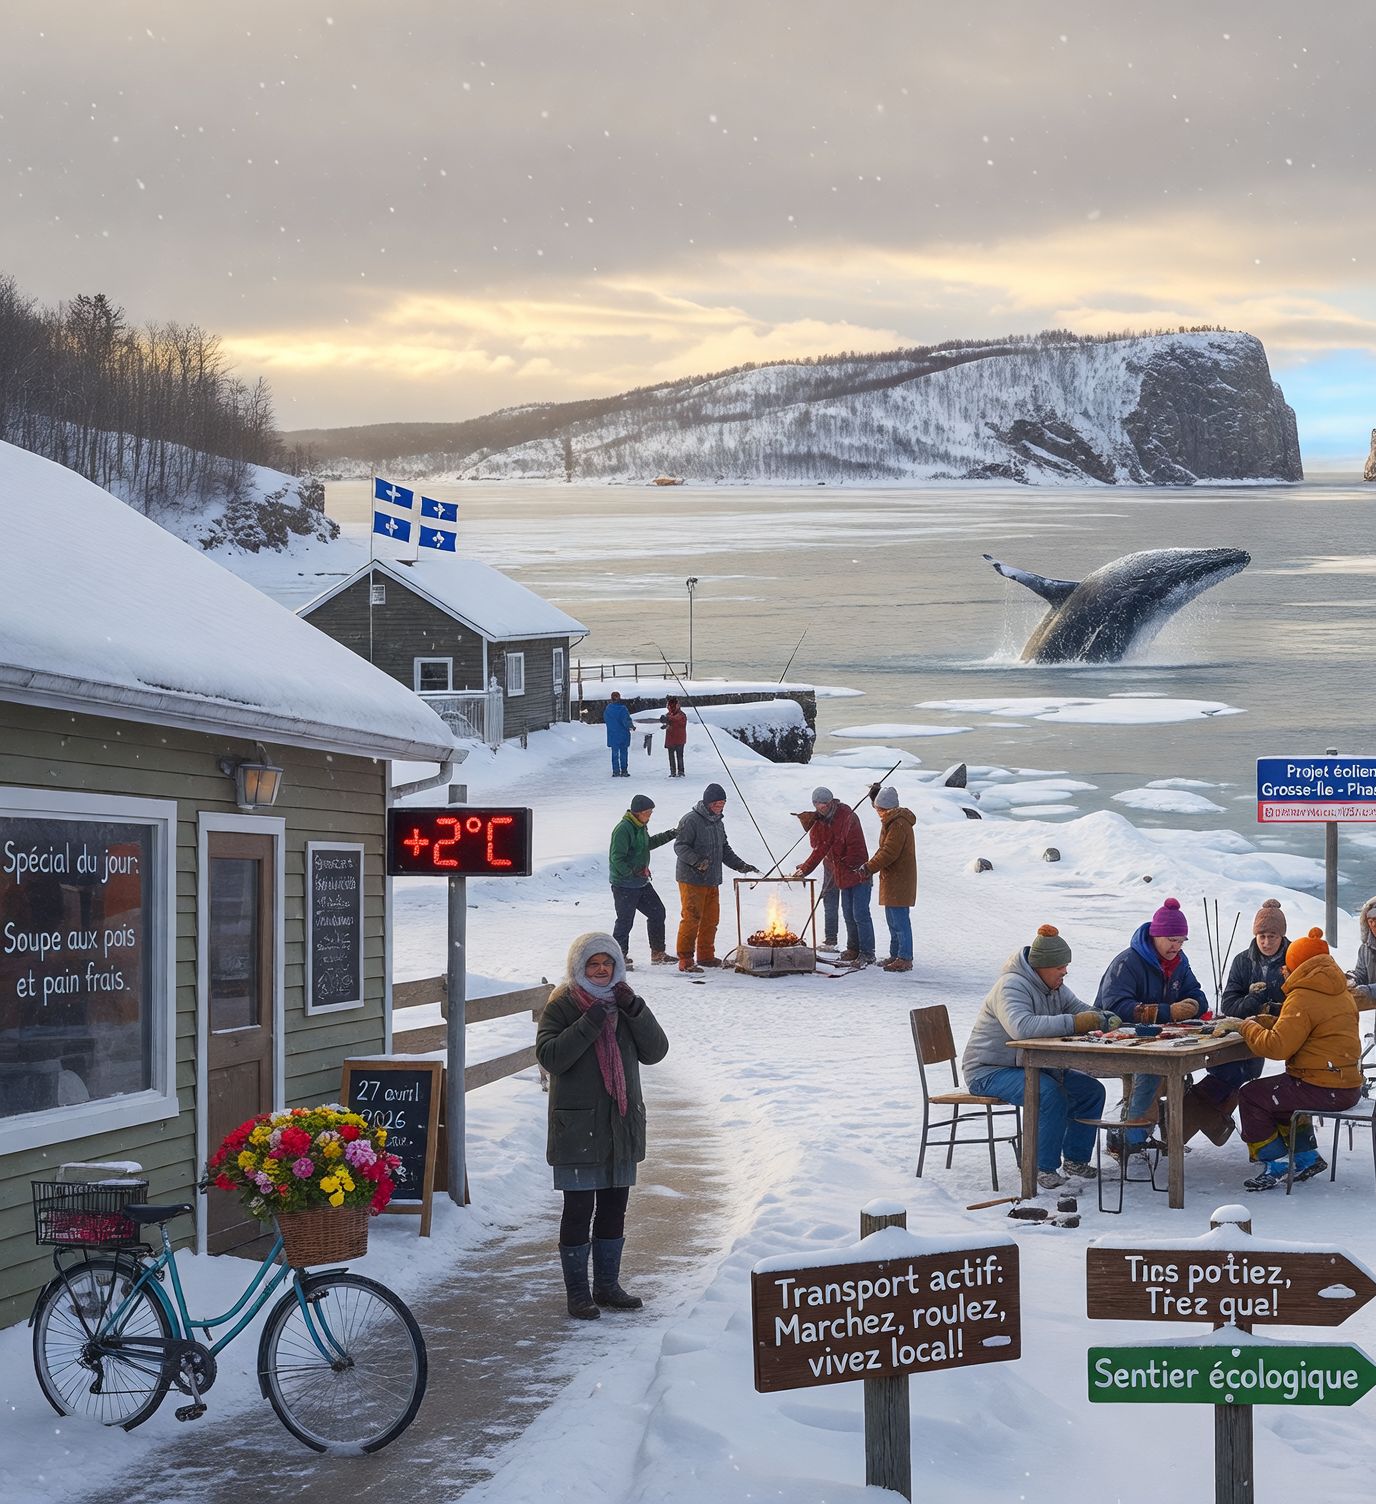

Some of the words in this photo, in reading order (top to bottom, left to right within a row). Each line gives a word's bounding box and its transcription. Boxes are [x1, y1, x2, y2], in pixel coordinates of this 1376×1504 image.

[1286, 764, 1329, 782] Projet
[3, 840, 70, 885] Spécial
[76, 843, 97, 874] du
[403, 816, 513, 867] +2°C
[4, 921, 61, 962] Soupe
[67, 930, 99, 951] aux
[104, 923, 136, 959] pois
[16, 968, 37, 998] et
[43, 968, 79, 1007] pain
[356, 1080, 381, 1101] 27
[774, 1264, 920, 1312] Transport
[929, 1255, 1004, 1293] actif:
[774, 1306, 905, 1347] Marchez,
[912, 1292, 1006, 1329] roulez,
[808, 1346, 882, 1378] vivez
[891, 1328, 964, 1367] local!
[1094, 1357, 1199, 1389] Sentier
[1208, 1357, 1359, 1400] écologique
